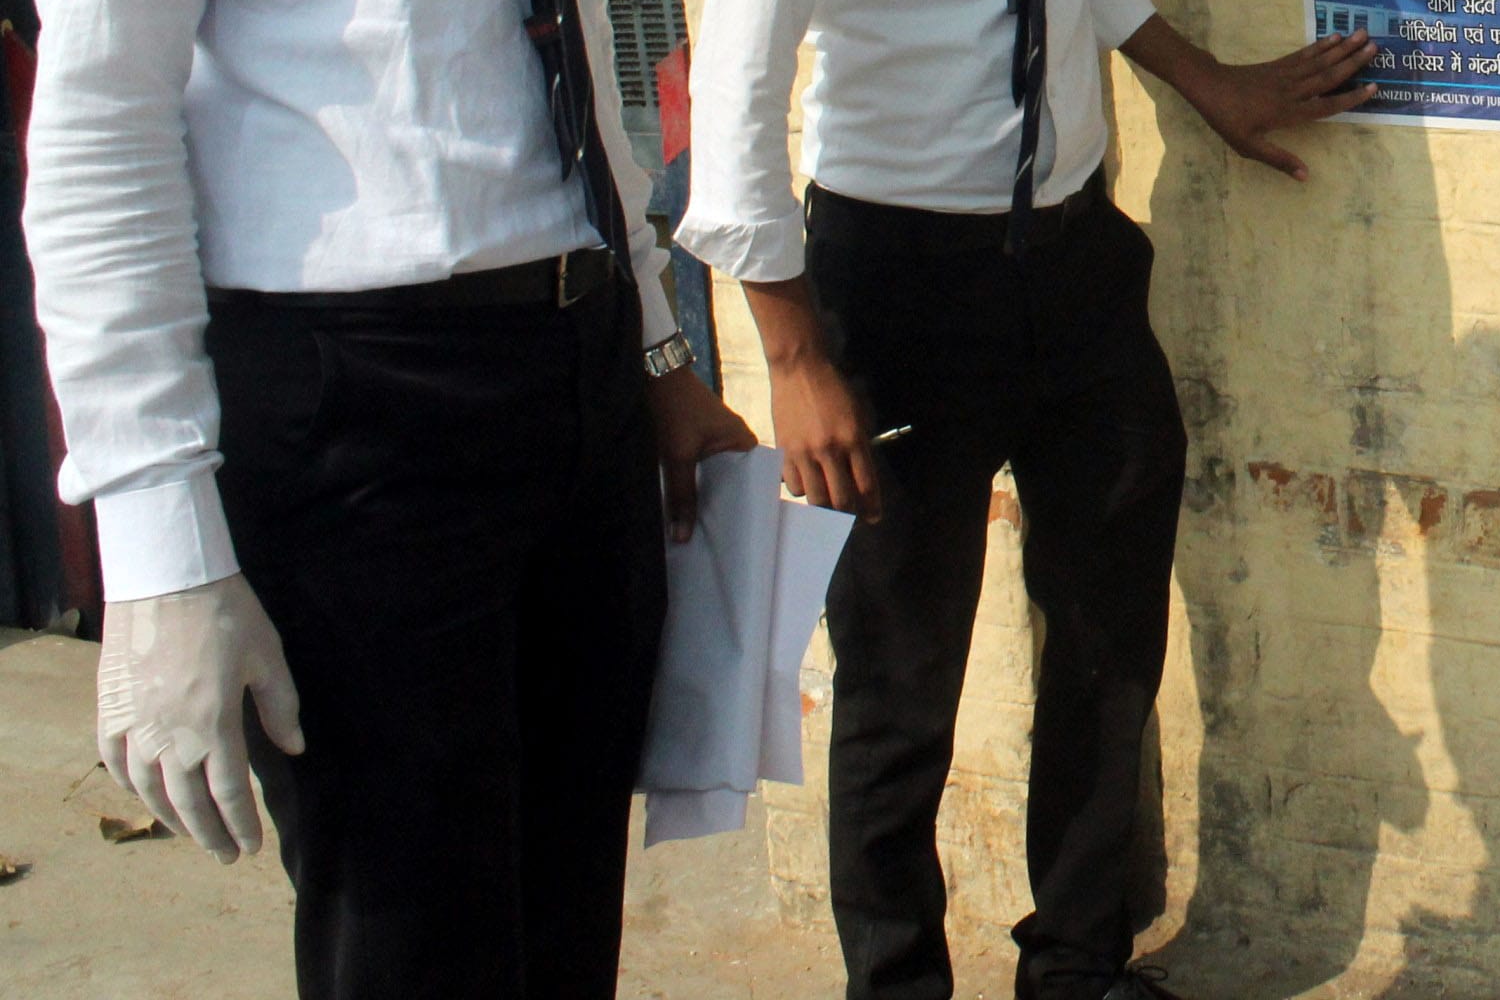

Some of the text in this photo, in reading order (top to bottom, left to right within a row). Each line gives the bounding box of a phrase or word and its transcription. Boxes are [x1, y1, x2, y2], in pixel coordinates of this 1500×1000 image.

[1464, 24, 1484, 44] एवं
[1403, 51, 1444, 71] परिसर
[1451, 51, 1461, 72] में
[1432, 93, 1470, 104] FACULTY
[1472, 96, 1484, 105] OF
